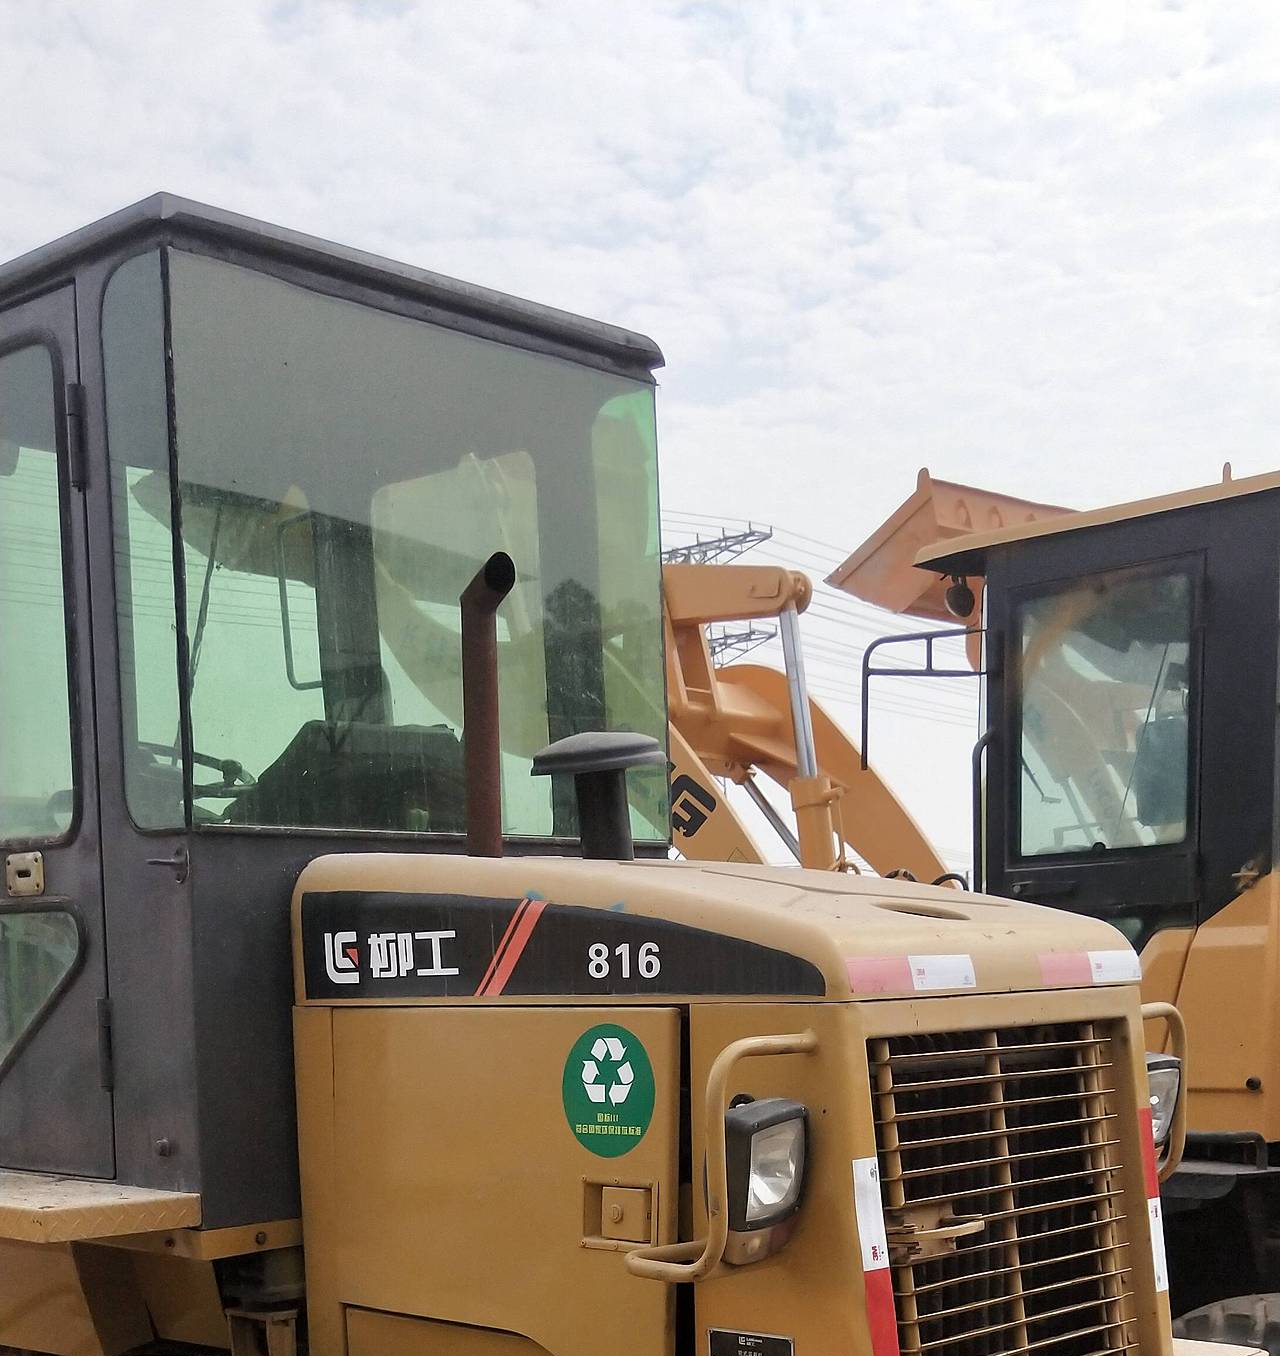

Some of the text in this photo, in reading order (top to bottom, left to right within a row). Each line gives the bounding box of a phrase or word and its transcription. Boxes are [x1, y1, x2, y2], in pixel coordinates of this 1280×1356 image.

[367, 930, 460, 978] 柳工
[588, 942, 661, 979] 816
[871, 1245, 879, 1261] 3M
